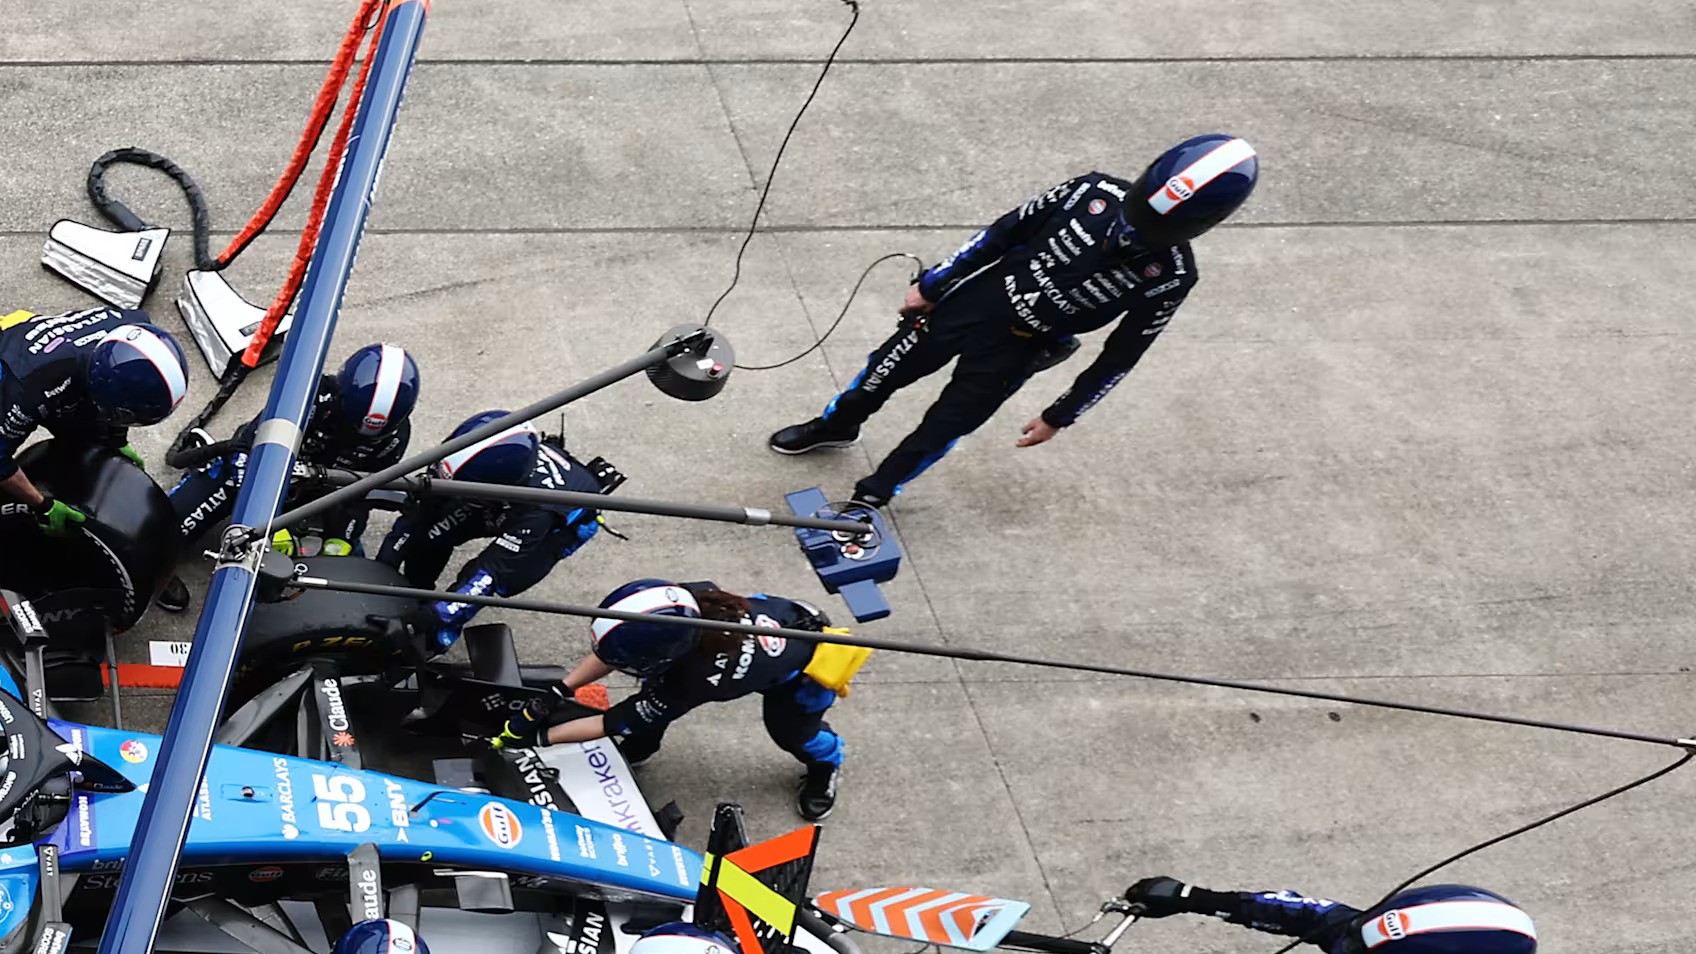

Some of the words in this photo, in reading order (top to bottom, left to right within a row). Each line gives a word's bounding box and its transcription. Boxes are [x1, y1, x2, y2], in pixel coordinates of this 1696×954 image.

[1169, 179, 1191, 199] Gulf
[1004, 274, 1052, 333] ATLASSIAN
[1032, 269, 1080, 316] BARCLAYS
[28, 311, 109, 355] ATLASSIAN
[861, 329, 919, 393] ATLASSIAN
[180, 486, 228, 536] ATLAS
[11, 604, 35, 634] SCORES
[21, 600, 44, 631] betway
[326, 678, 350, 732] Claude
[273, 757, 298, 825] BARCLAYS
[311, 773, 372, 833] 55
[383, 778, 411, 829] BNY
[78, 795, 91, 847] KOMATSU
[492, 805, 509, 845] Gulf
[92, 858, 126, 871] bril
[359, 869, 380, 920] aude
[1382, 909, 1403, 939] Gulf
